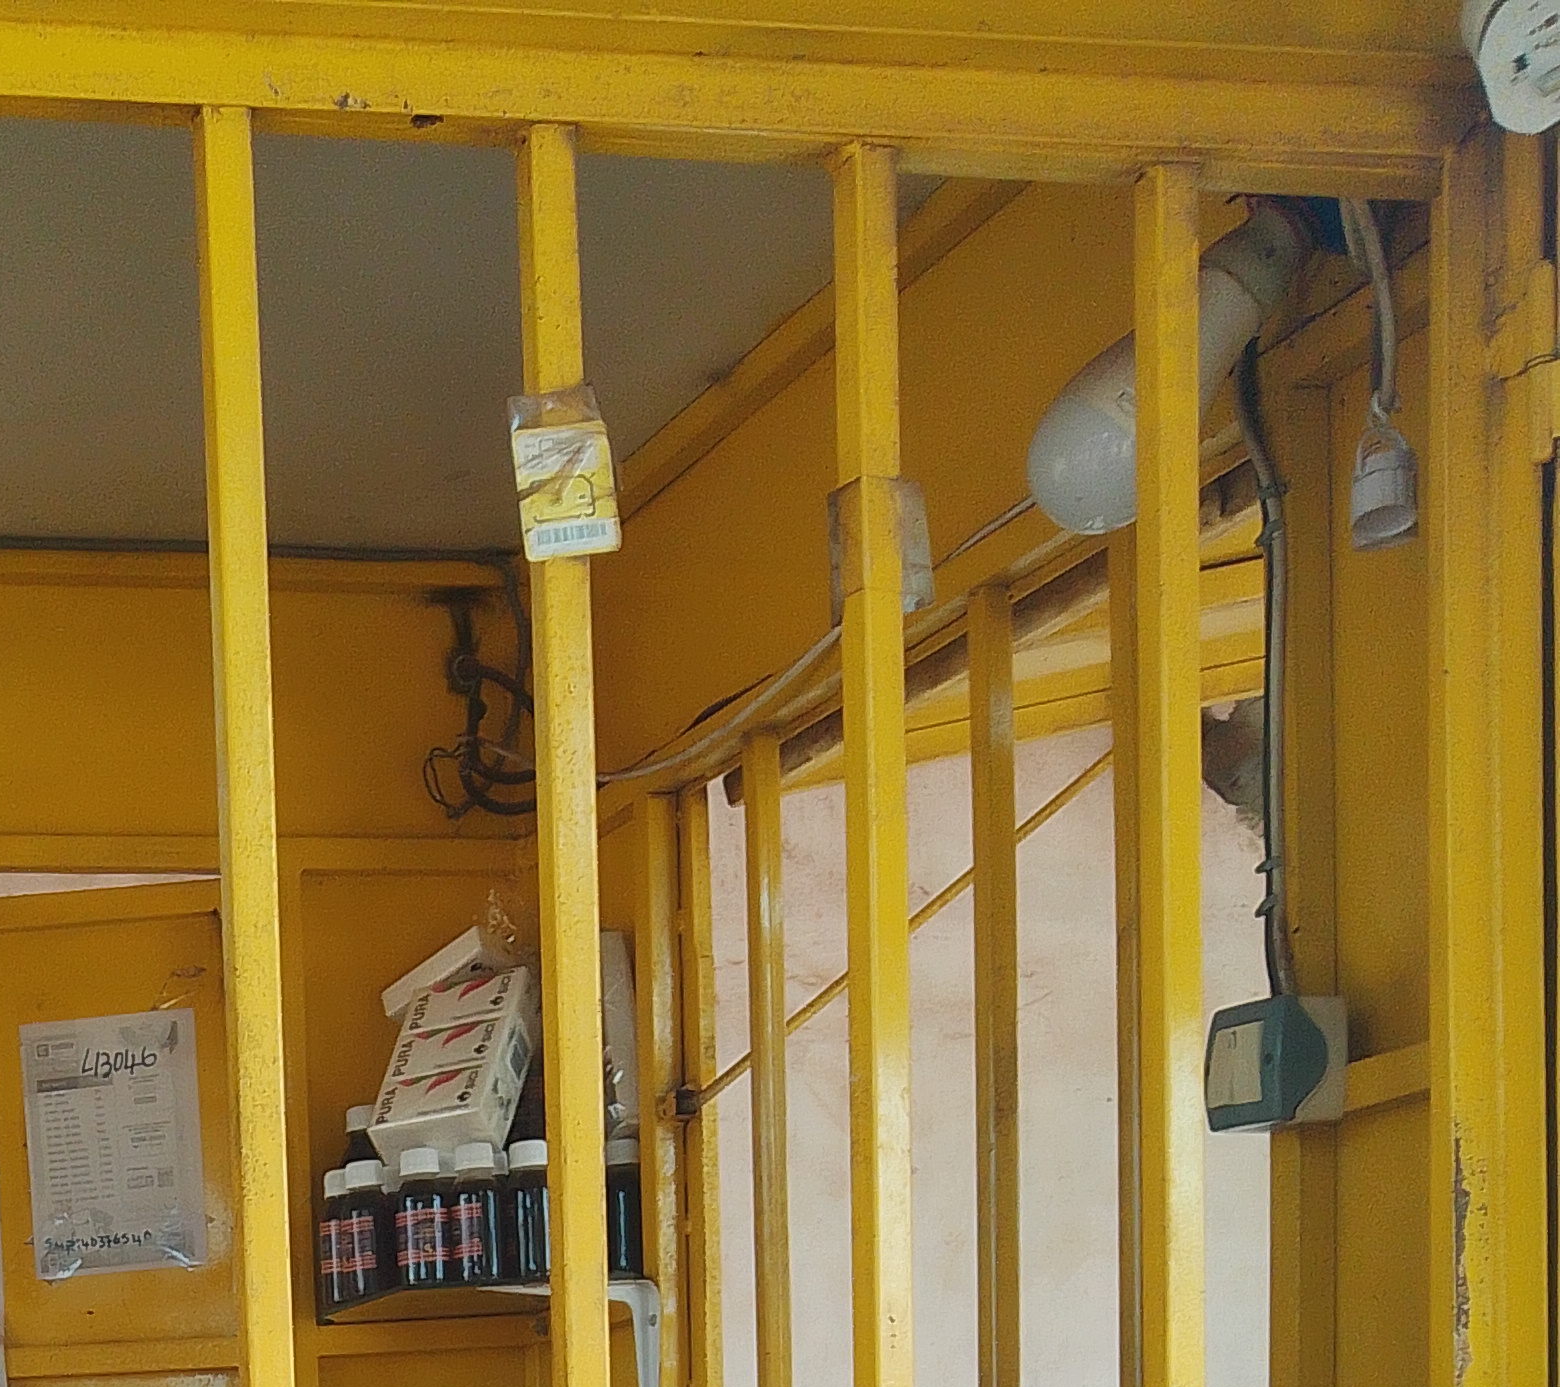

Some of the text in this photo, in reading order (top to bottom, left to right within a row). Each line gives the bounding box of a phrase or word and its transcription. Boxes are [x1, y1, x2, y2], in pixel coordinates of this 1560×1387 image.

[408, 993, 431, 1031] PURA
[392, 1039, 416, 1078] PURA
[375, 1086, 399, 1126] PURA
